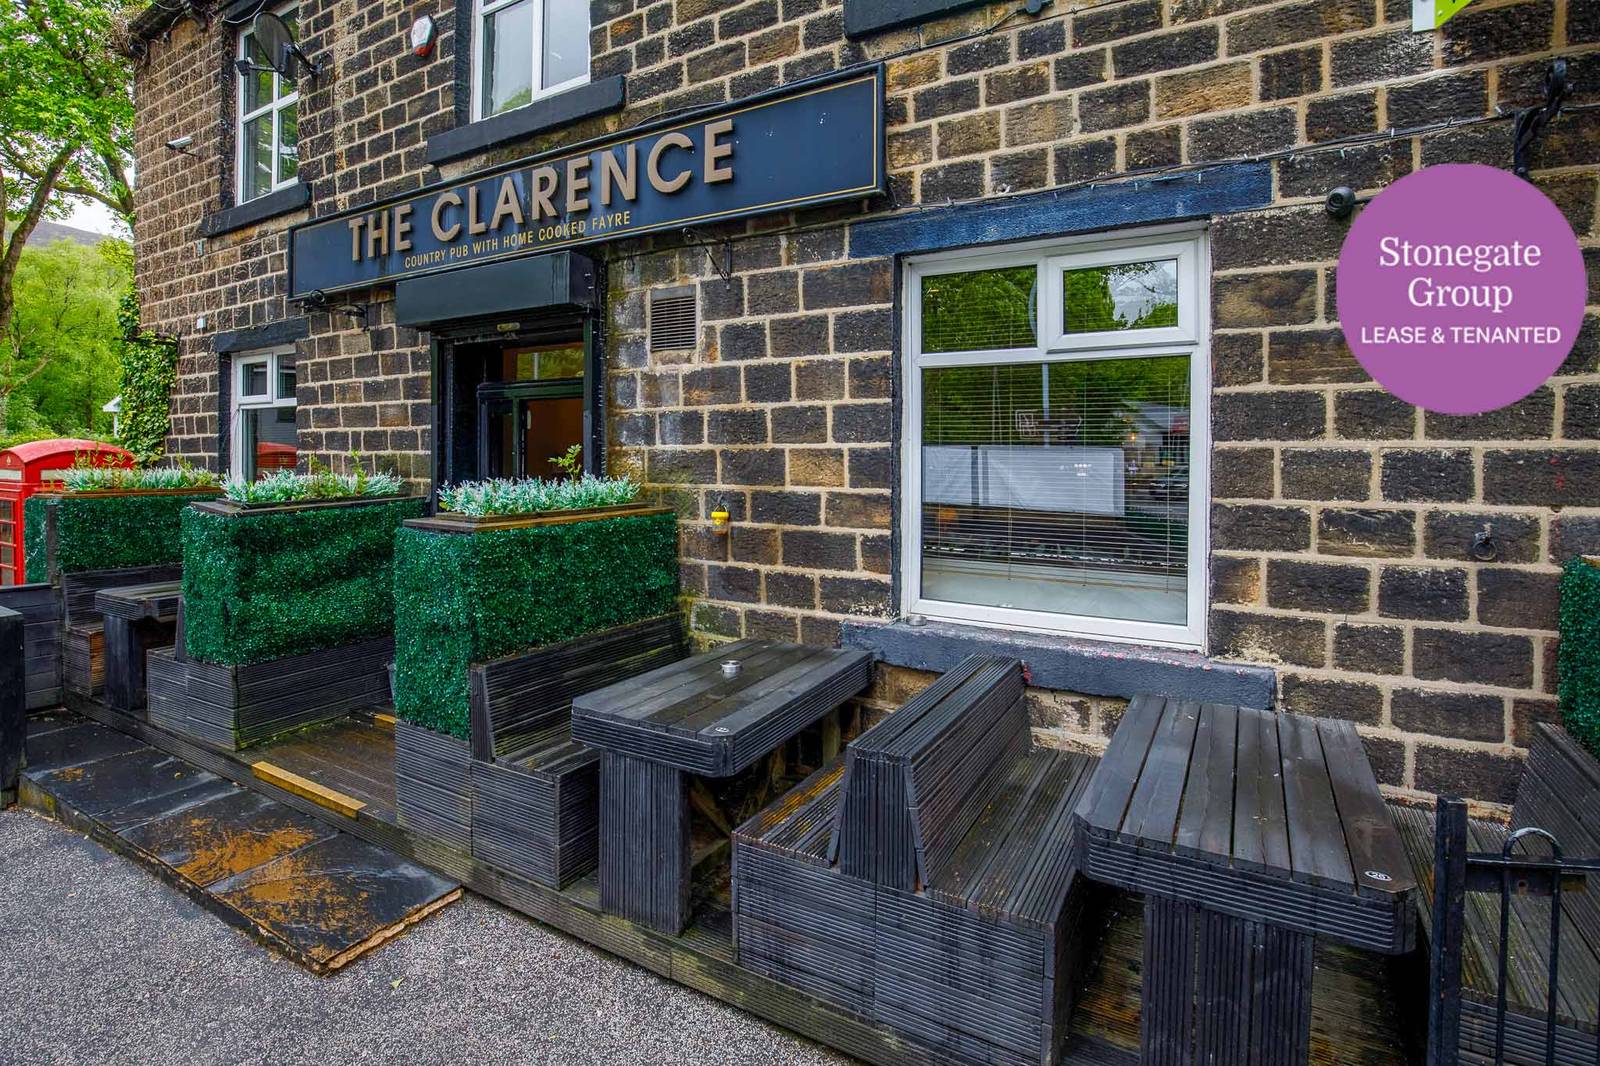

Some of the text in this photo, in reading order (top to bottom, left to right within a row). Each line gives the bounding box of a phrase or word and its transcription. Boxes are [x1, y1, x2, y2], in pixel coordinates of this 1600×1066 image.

[349, 119, 734, 261] THE CLARENCE
[404, 211, 630, 269] COUNTRY PUB WITH HOME COOKED FAYRE
